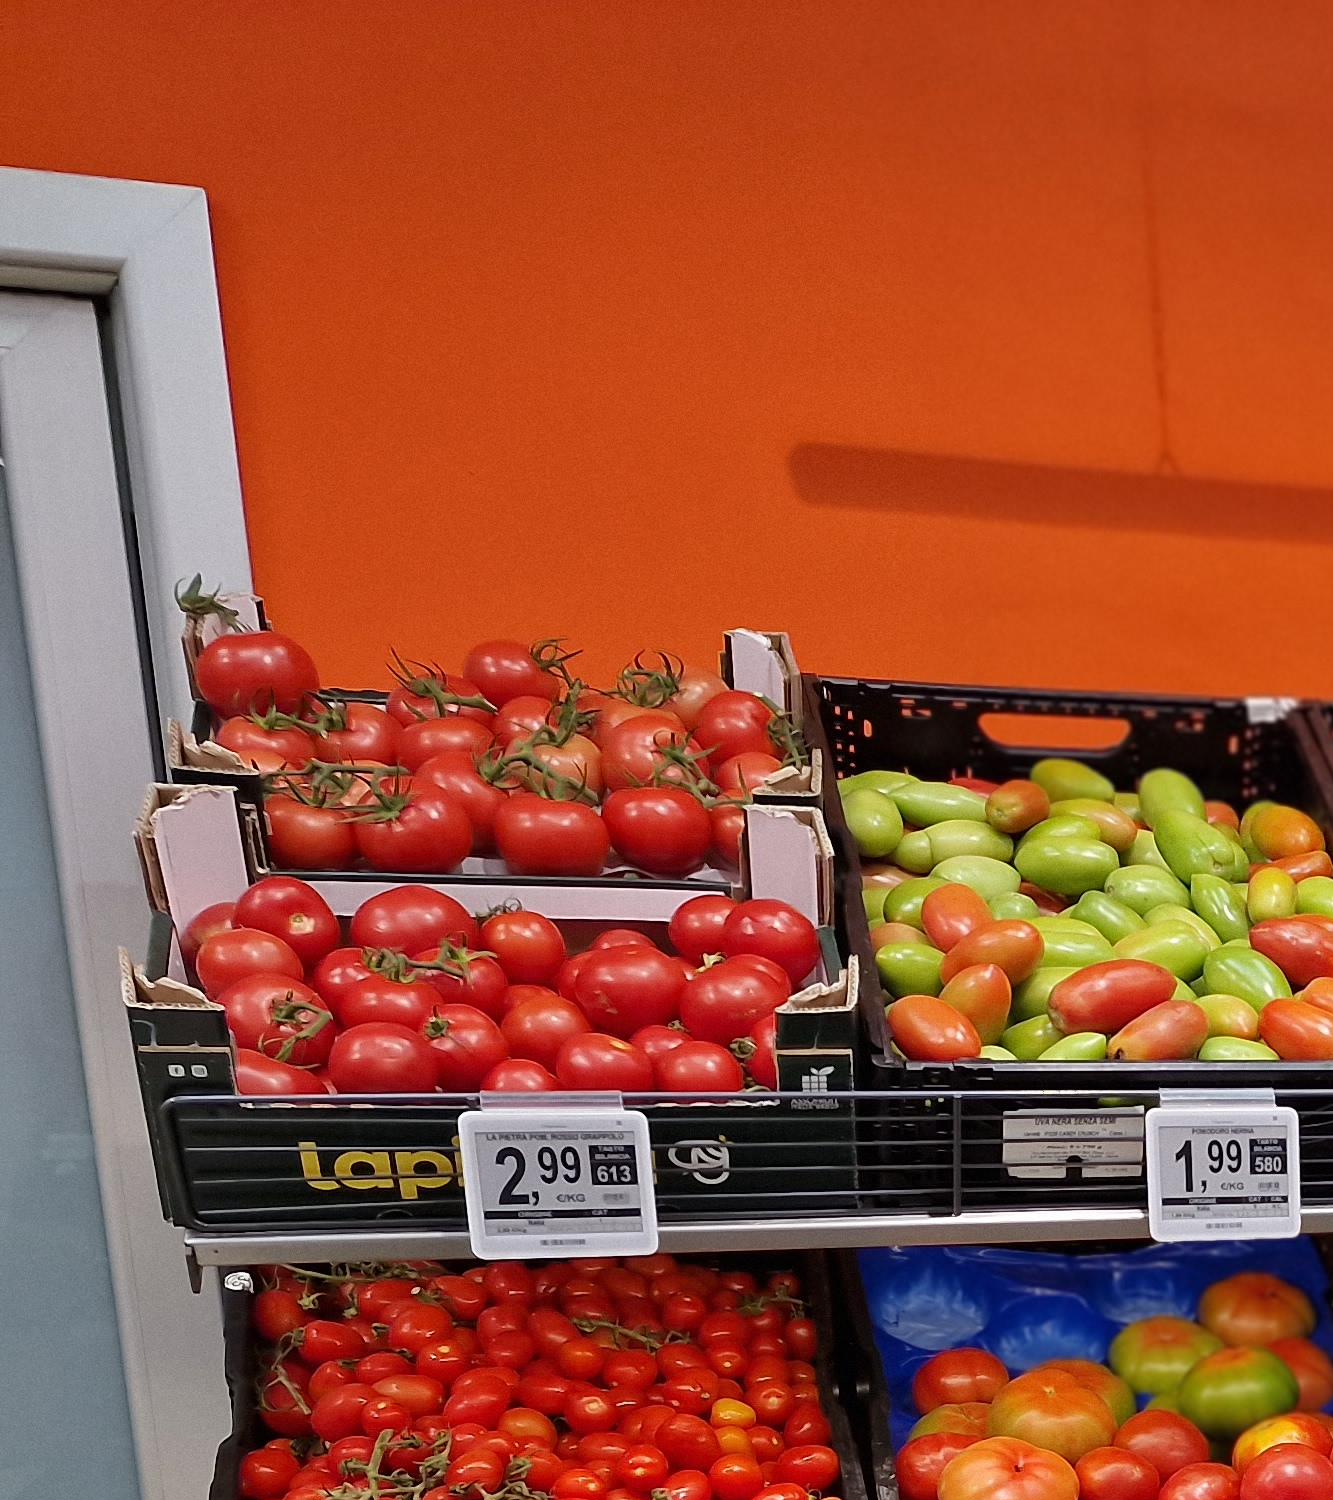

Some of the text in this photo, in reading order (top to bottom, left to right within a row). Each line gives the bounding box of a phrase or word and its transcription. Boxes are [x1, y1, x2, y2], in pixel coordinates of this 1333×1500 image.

[1175, 1140, 1242, 1193] 1,99
[1254, 1157, 1282, 1172] 580
[496, 1147, 581, 1206] 2,99
[597, 1165, 631, 1182] 613
[1220, 1182, 1244, 1190] €/KG
